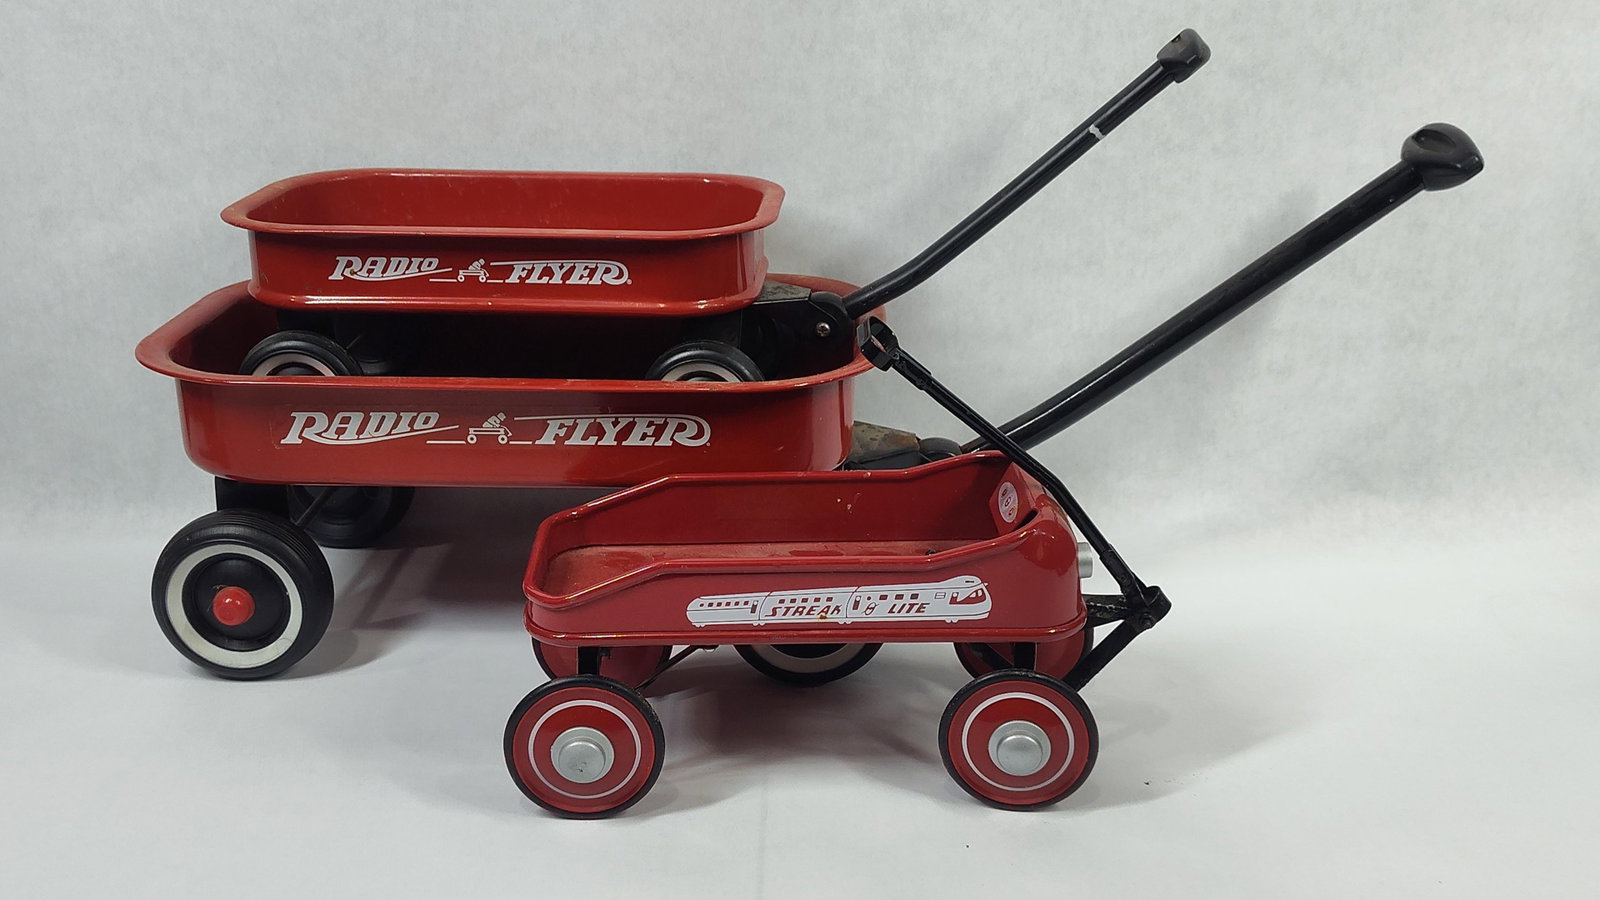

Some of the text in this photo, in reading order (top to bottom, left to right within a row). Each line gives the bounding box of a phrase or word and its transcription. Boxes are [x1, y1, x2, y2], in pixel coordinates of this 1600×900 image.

[328, 256, 450, 281] RADIO
[280, 411, 458, 445] RADIO
[765, 602, 930, 617] STREAK LITE
